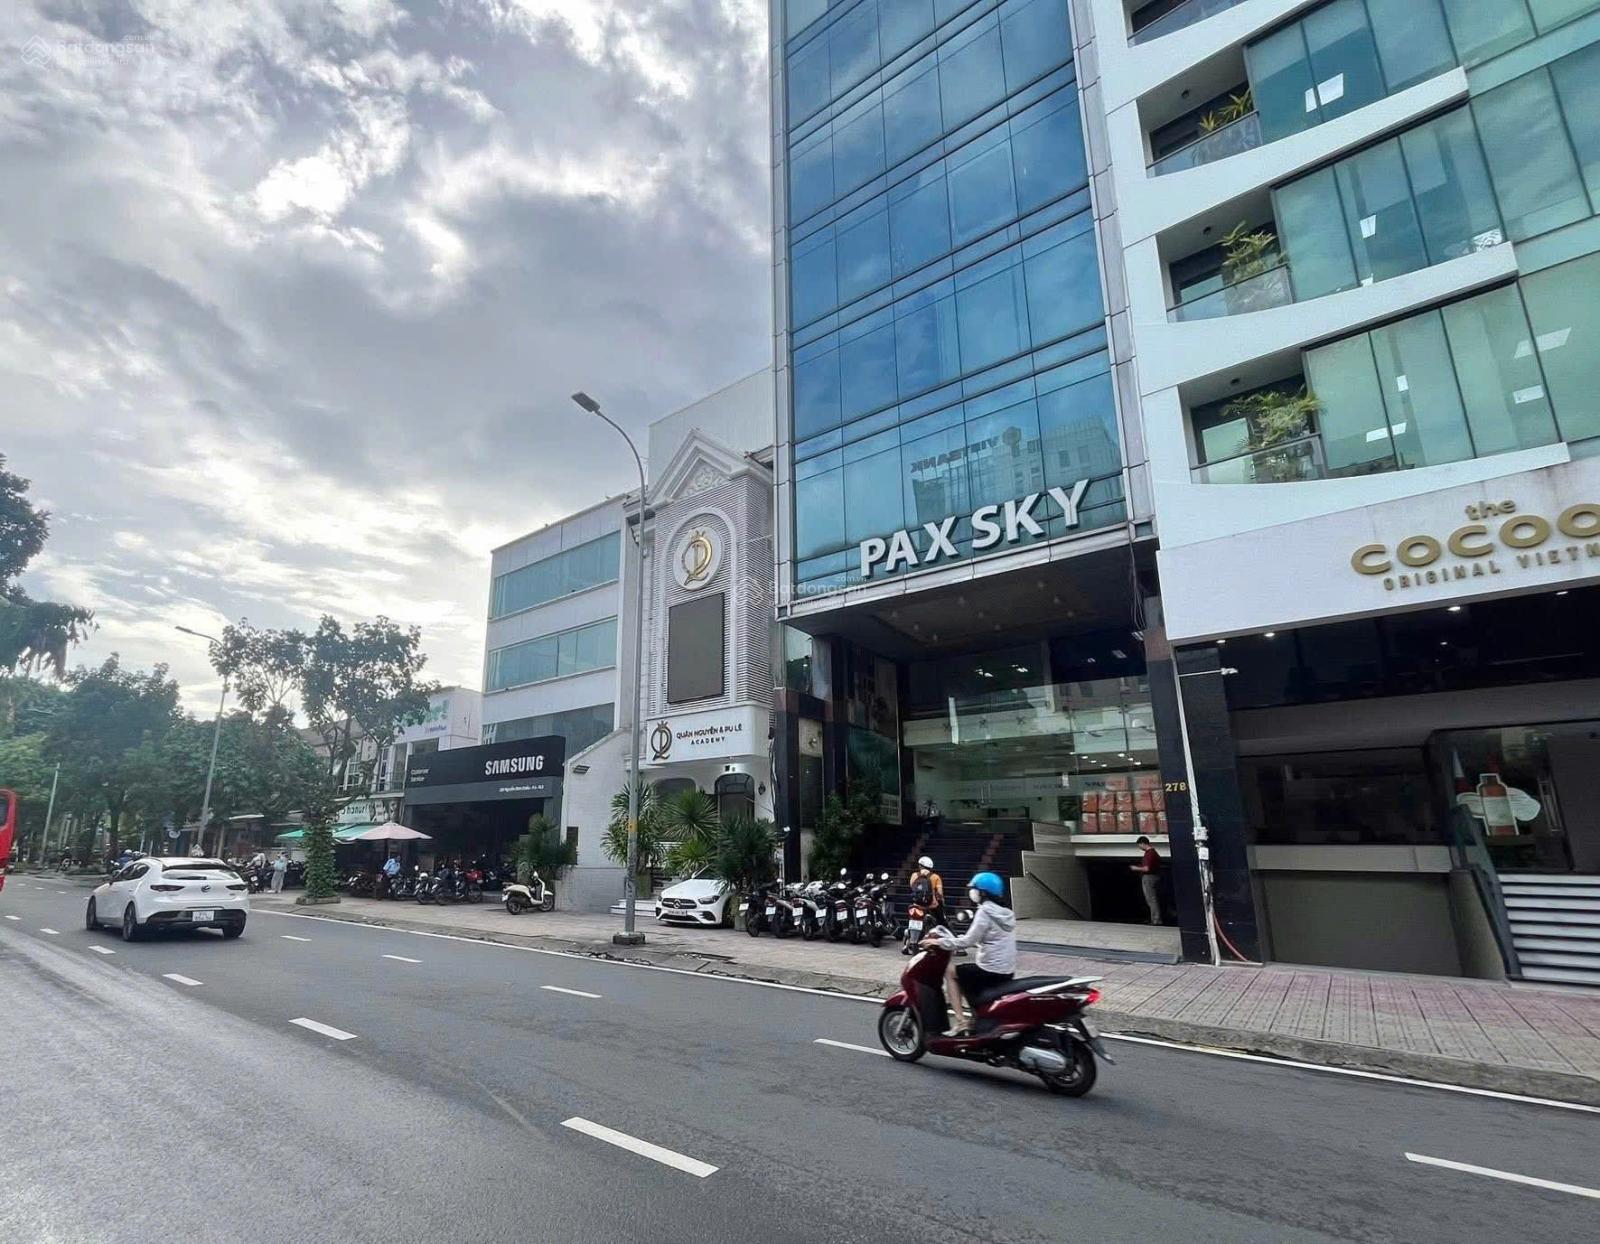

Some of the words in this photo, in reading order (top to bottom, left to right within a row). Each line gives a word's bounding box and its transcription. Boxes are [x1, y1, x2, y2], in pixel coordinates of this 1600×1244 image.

[1465, 499, 1516, 520] the
[860, 515, 960, 578] PAX
[971, 478, 1091, 549] SKY
[1383, 560, 1500, 591] ORIGINAL
[691, 737, 725, 745] ACADEMY
[485, 755, 544, 776] SAMSUNG
[1165, 782, 1187, 792] 278
